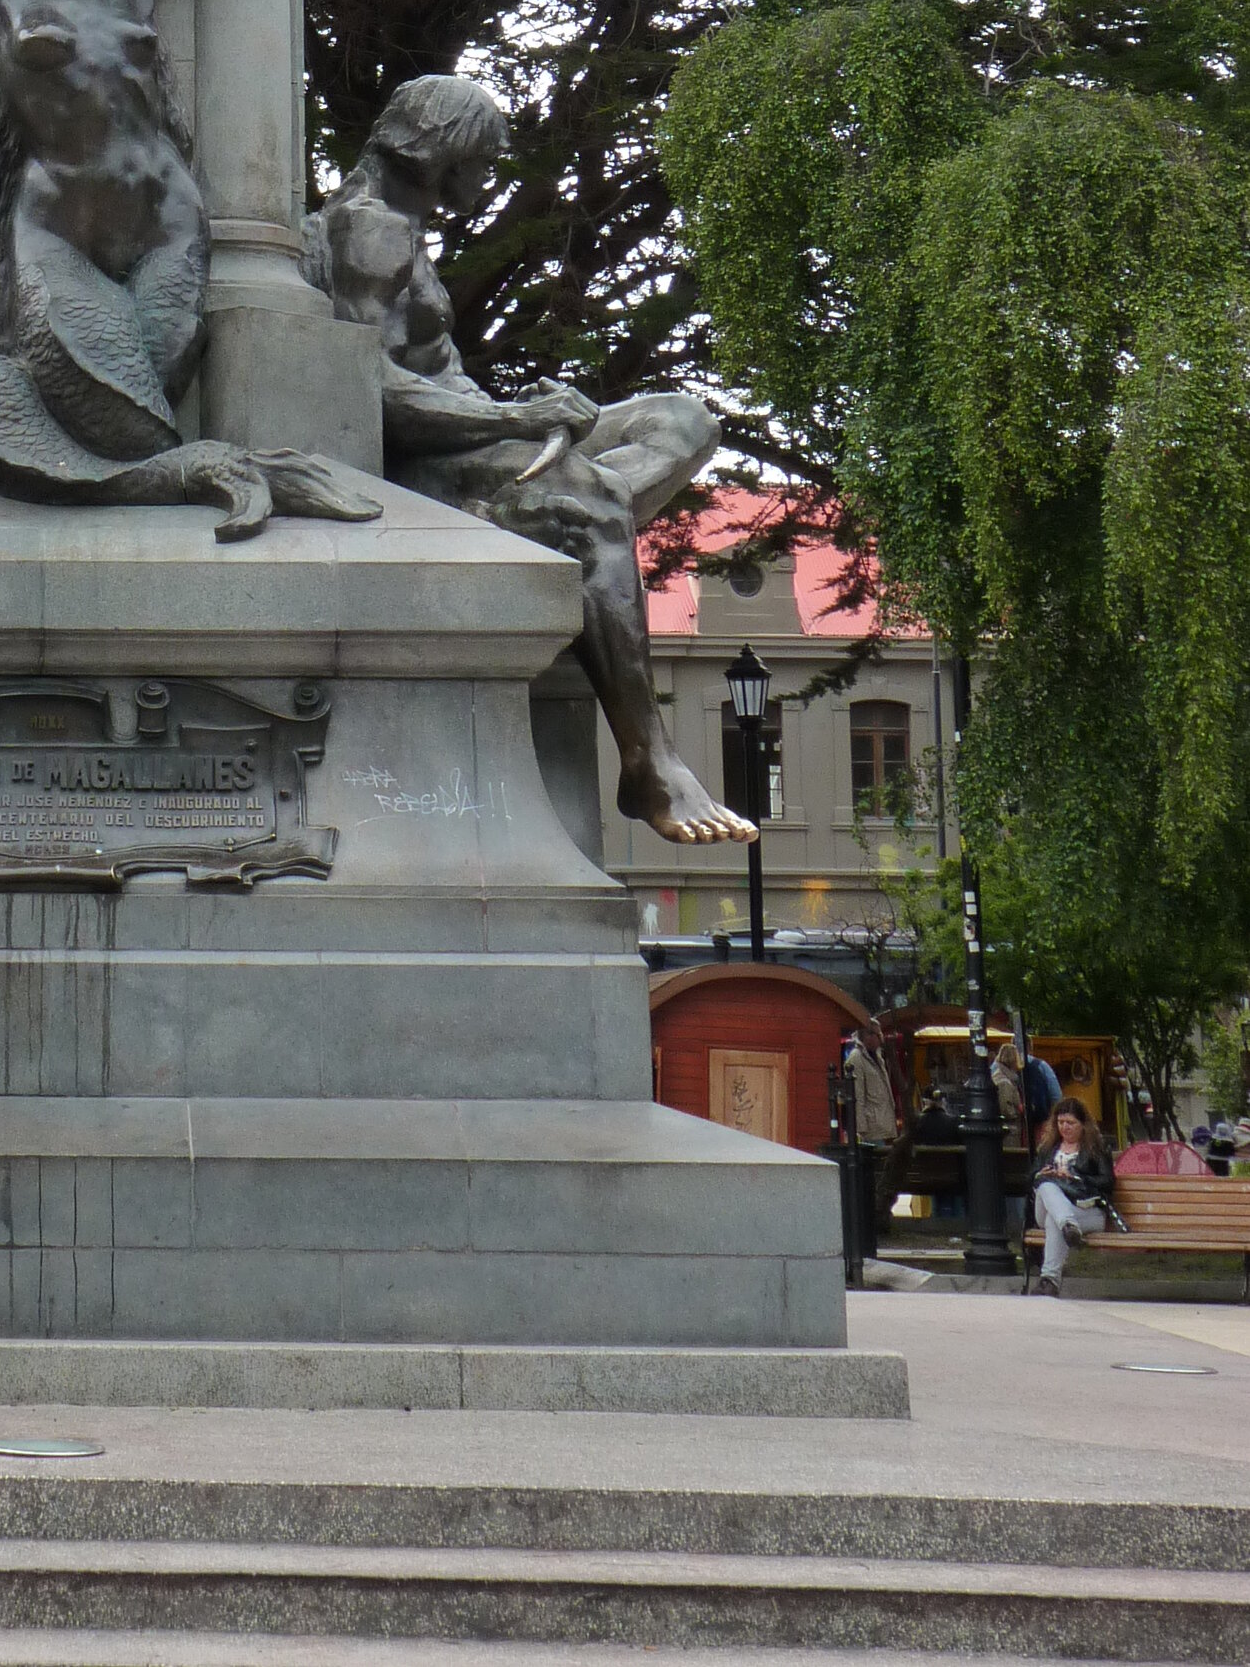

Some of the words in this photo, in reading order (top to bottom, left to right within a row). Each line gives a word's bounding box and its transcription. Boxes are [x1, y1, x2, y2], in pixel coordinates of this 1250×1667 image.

[11, 760, 35, 783] DE
[44, 752, 255, 792] MAGALLANES
[16, 795, 53, 809] JOSE
[58, 796, 132, 810] MENENDEZ
[153, 797, 240, 811] INAUGURADO
[245, 796, 264, 811] AL
[0, 812, 94, 827] CENTENARIO
[105, 814, 134, 827] DEL
[145, 814, 265, 829] DESCUBRIMIENTO
